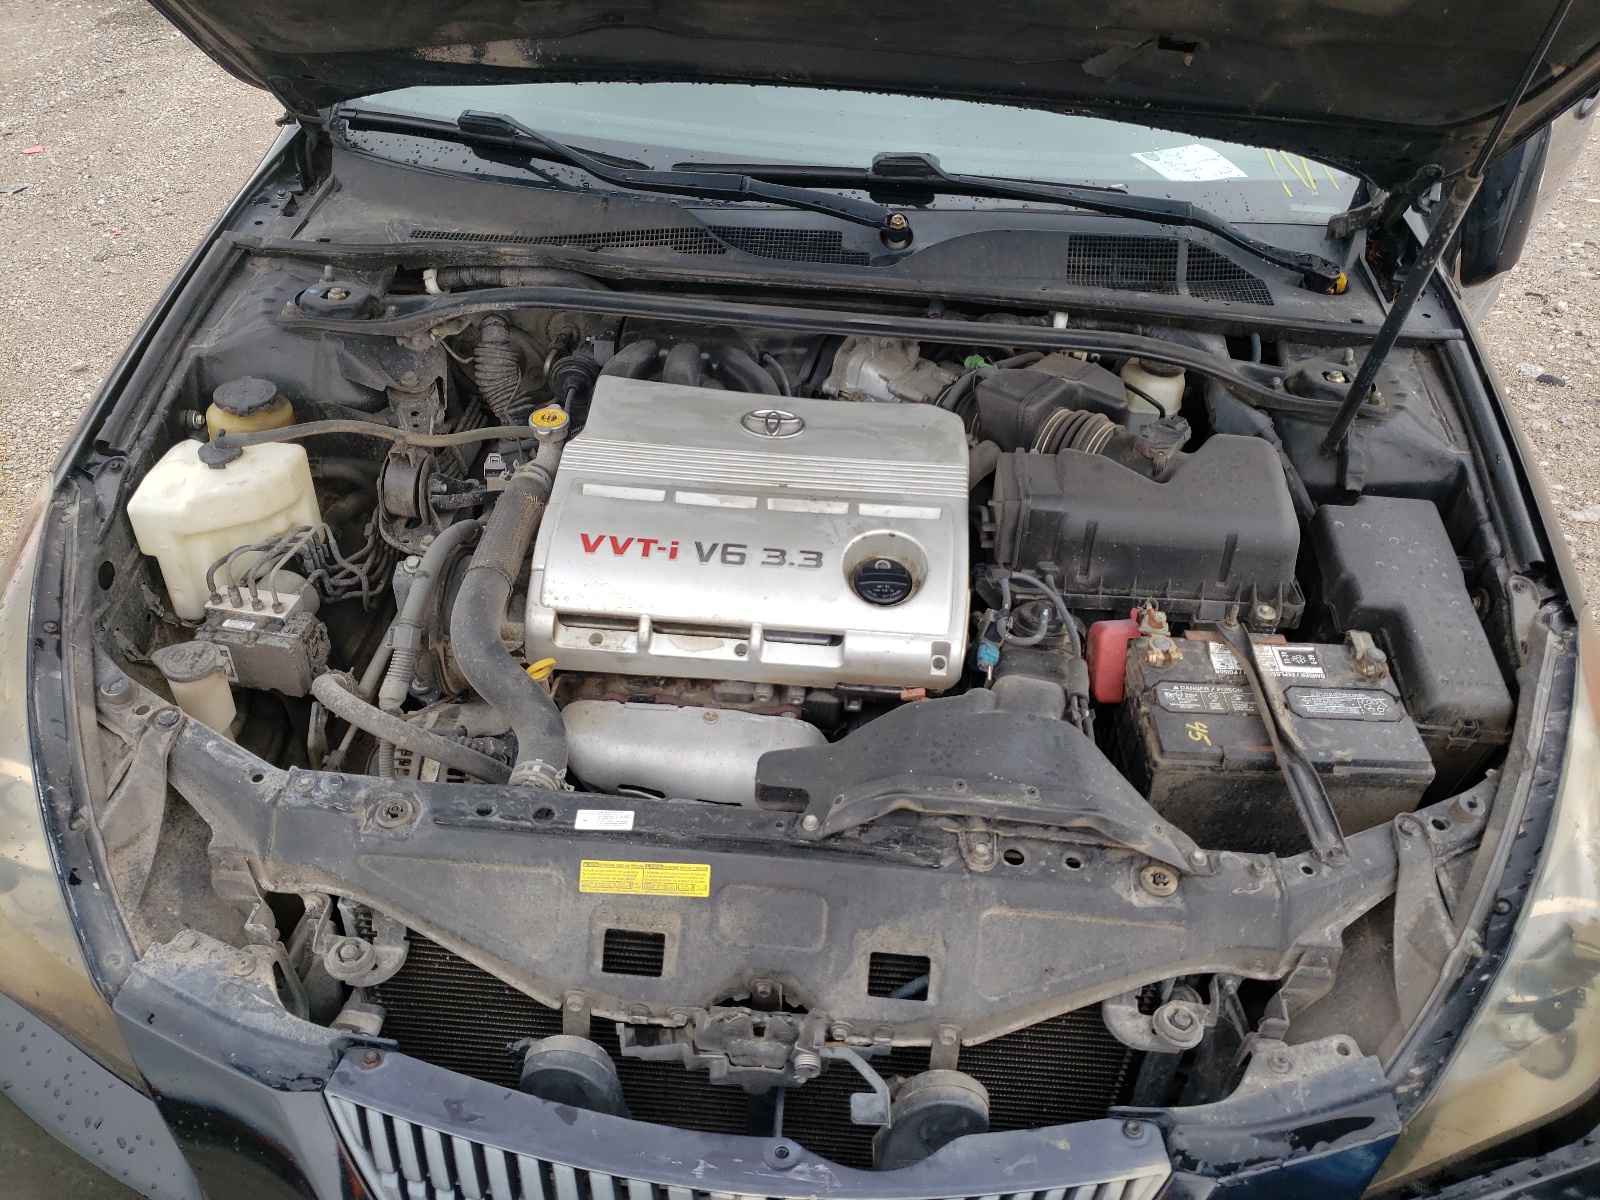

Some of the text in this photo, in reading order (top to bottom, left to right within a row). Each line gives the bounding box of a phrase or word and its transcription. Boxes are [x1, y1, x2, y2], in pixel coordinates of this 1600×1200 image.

[580, 533, 823, 569] VVT-i V6 3.3
